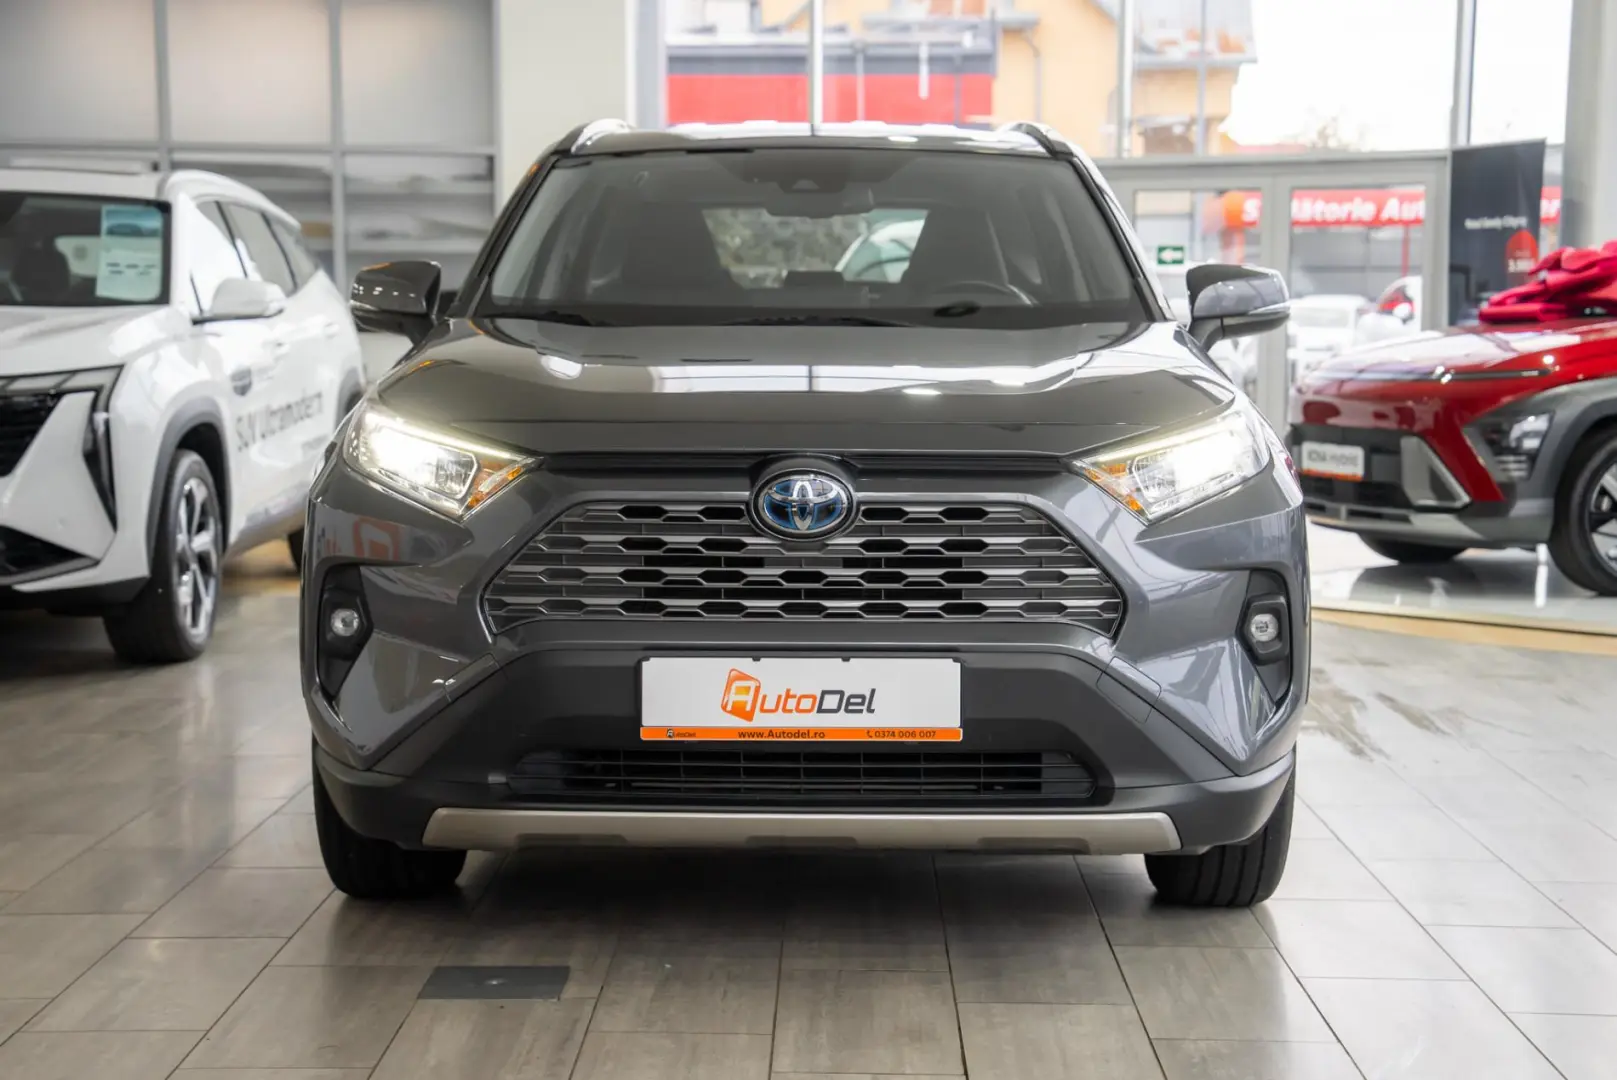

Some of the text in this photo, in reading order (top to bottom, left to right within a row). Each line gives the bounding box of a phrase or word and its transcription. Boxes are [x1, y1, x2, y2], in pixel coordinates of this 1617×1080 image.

[1379, 197, 1426, 222] Aut
[721, 670, 876, 721] AutoDel
[737, 729, 826, 740] www.Autodel.ro
[874, 730, 896, 739] 0374
[899, 730, 917, 739] 006
[918, 730, 937, 739] 007
